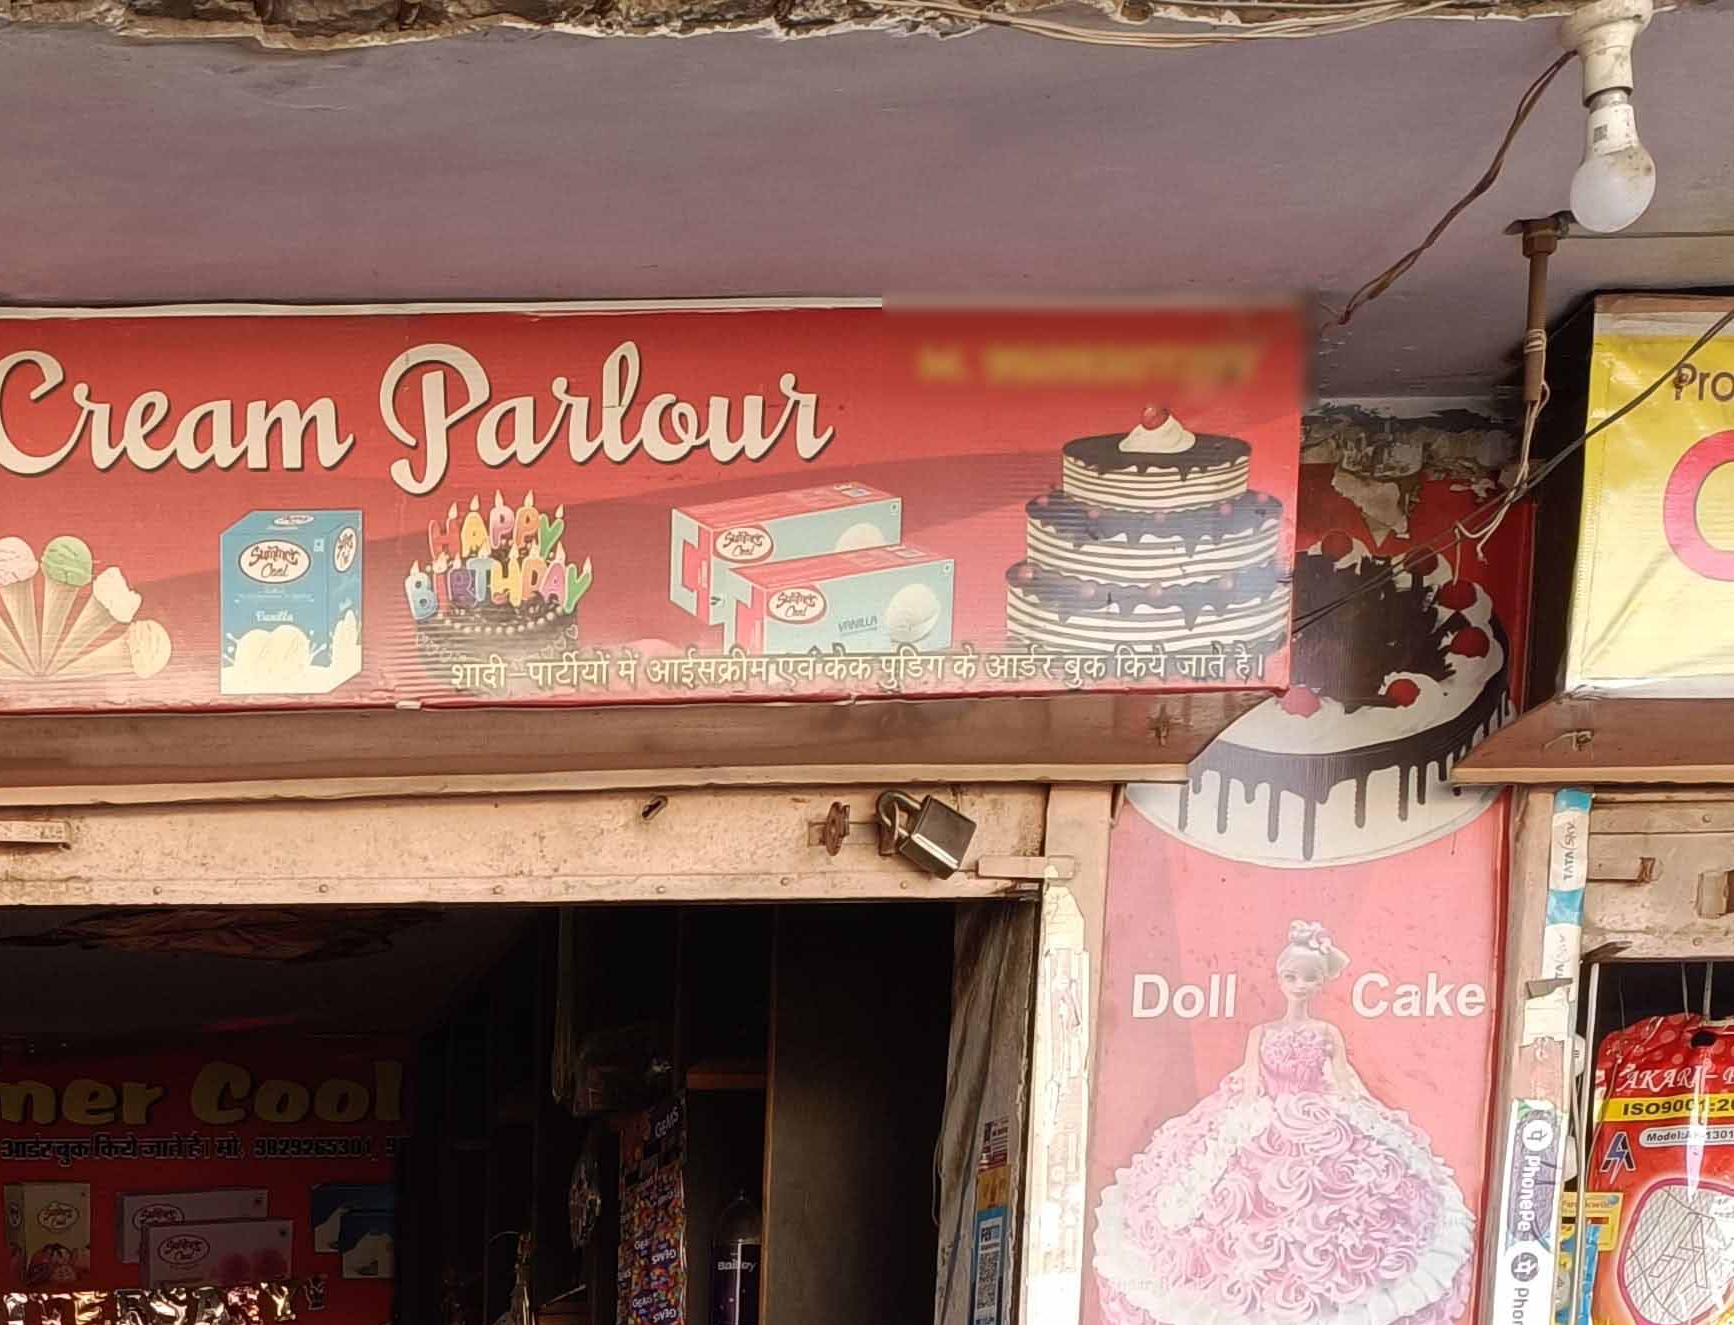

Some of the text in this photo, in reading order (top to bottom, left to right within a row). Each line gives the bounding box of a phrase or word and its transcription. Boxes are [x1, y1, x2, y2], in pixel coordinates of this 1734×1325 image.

[379, 340, 835, 496] Parlour
[1130, 972, 1488, 1019] Doll Cake
[190, 1059, 404, 1126] Cool
